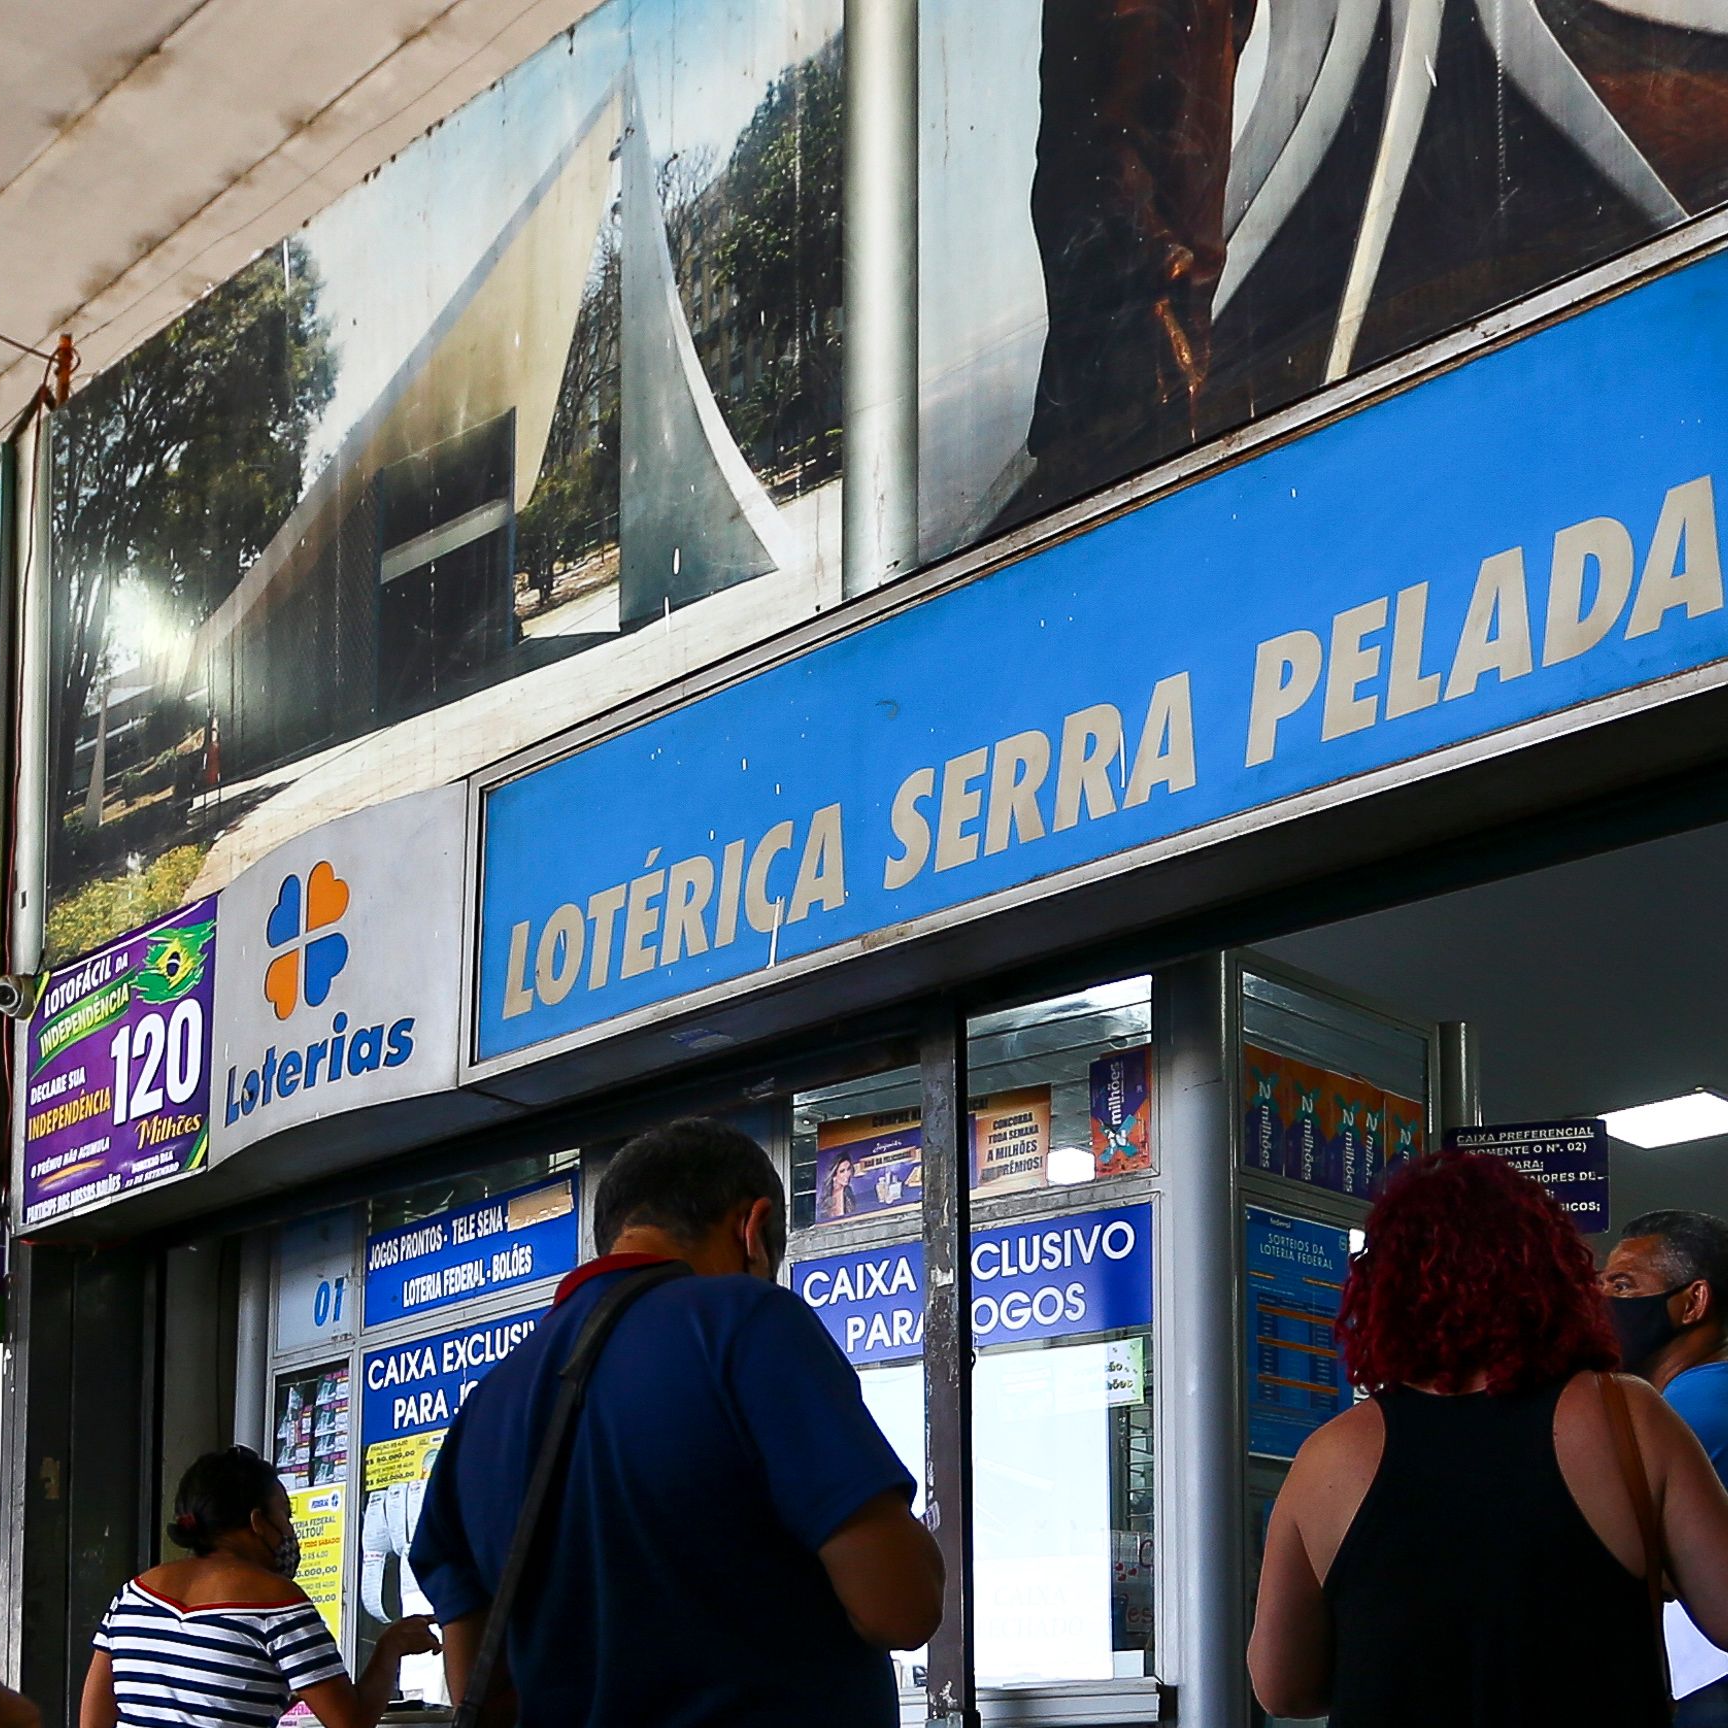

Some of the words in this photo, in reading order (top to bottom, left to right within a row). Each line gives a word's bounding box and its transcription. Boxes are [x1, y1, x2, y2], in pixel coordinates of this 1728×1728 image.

[501, 801, 845, 1020] LOTÉRICA
[883, 671, 1198, 894] SERRA
[1245, 475, 1726, 768] PELADA
[44, 961, 112, 1018] LOTOFÁCIL
[116, 953, 128, 974] DA
[40, 982, 129, 1058] INDEPENDÊNCIA
[31, 1074, 67, 1105] DECLARE
[68, 1067, 86, 1087] SUA
[110, 999, 202, 1125] 120
[225, 1012, 415, 1128] Loterias
[28, 1087, 111, 1141] INDEPENDÊNCIA
[136, 1114, 201, 1150] Milhões
[988, 1131, 1008, 1144] TODA
[1008, 1125, 1039, 1142] SEMANA
[993, 1112, 1033, 1130] CONCORRA
[1261, 1105, 1270, 1168] milhões
[1457, 1133, 1494, 1143] CAIXA
[1499, 1127, 1594, 1140] PREFERENCIAL
[987, 1150, 993, 1162] A
[995, 1140, 1038, 1161] MILHÕES
[1304, 1119, 1313, 1181] milhões
[1345, 1132, 1354, 1193] milhões
[1533, 1145, 1542, 1153] O
[1567, 1142, 1587, 1152] 02)
[368, 1239, 399, 1271] JOGOS
[401, 1225, 443, 1262] PRONTOS
[452, 1215, 475, 1245] TELE
[478, 1206, 503, 1238] SENA
[803, 1257, 917, 1308] CAIXA
[971, 1221, 1135, 1281] CLUSIVO
[1260, 1243, 1295, 1261] LOTERIA
[1298, 1253, 1333, 1270] FEDERAL
[1268, 1233, 1309, 1252] SORTEIOS
[1312, 1244, 1325, 1256] DA
[403, 1272, 442, 1308] LOTERIA
[443, 1261, 485, 1297] FEDERAL
[493, 1243, 532, 1283] BOLÕES
[314, 1277, 347, 1328] 01
[972, 1283, 1086, 1336] OGOS
[368, 1347, 436, 1390] CAIXA
[443, 1320, 535, 1373] EXCLUSI
[394, 1389, 448, 1430] PARA
[296, 1526, 324, 1539] OLTOU!
[310, 1516, 336, 1526] FEDERAL
